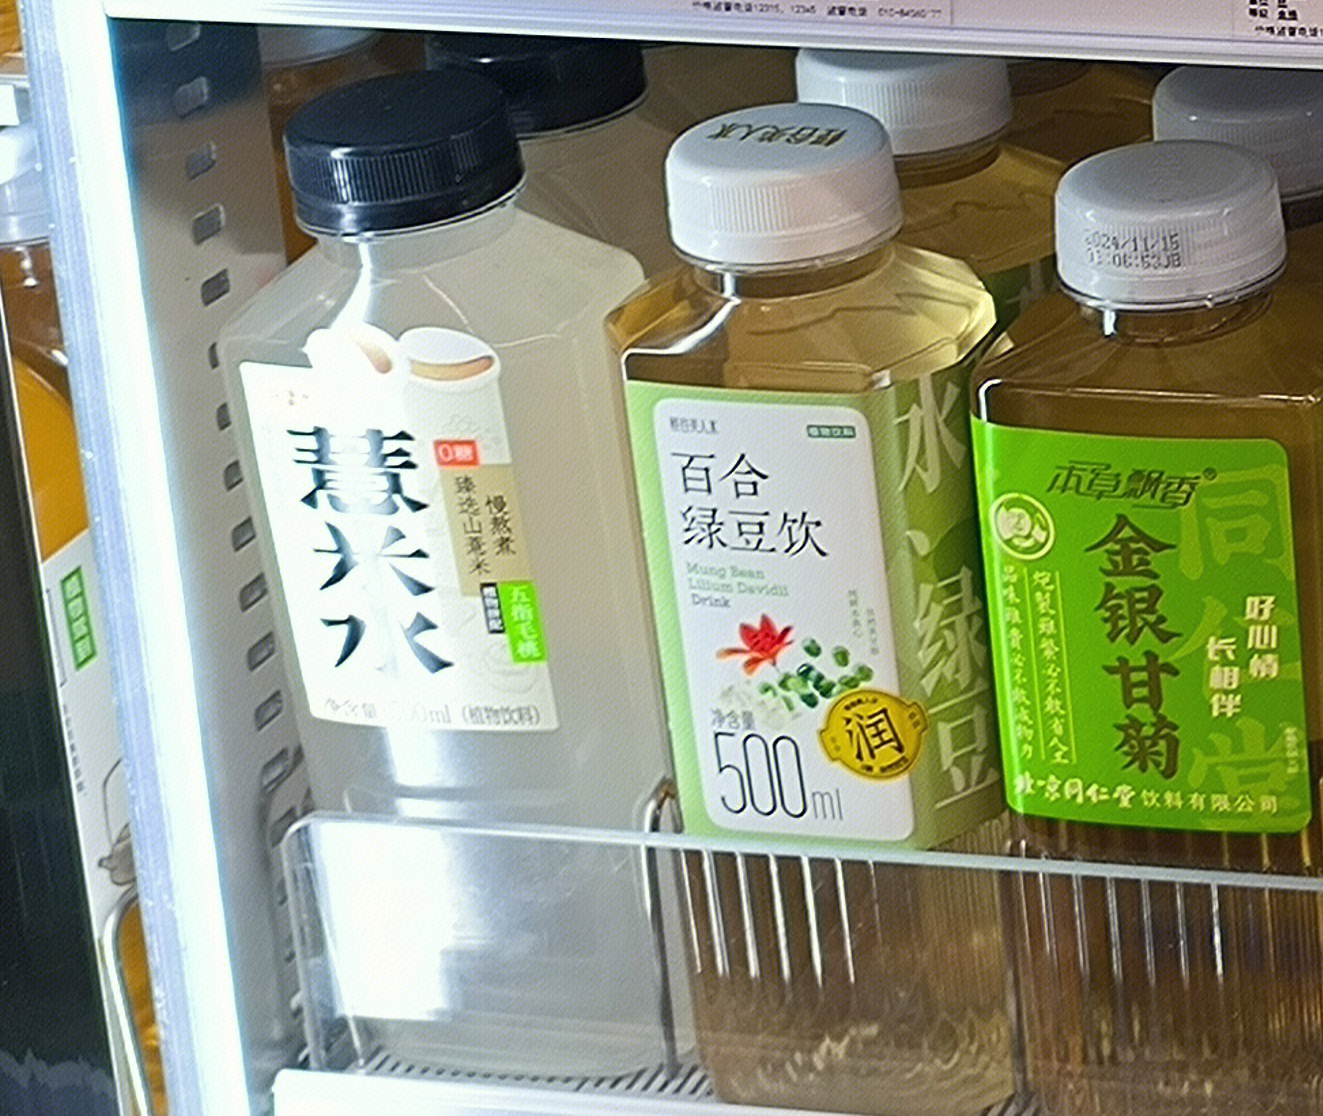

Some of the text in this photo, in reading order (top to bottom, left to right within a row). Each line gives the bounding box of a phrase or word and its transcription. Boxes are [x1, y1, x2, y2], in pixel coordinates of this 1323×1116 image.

[671, 452, 769, 499] 百合
[1046, 460, 1201, 509] 本草飘香
[286, 425, 455, 675] 薏米水
[680, 505, 828, 558] 绿豆饮
[1085, 513, 1182, 780] 金银甘菊
[1245, 595, 1281, 680] 好心情
[1207, 636, 1242, 718] 长相伴
[843, 708, 904, 761] 润
[713, 731, 843, 820] 500ml
[1015, 772, 1279, 815] 北京同仁堂饮料有限公司
